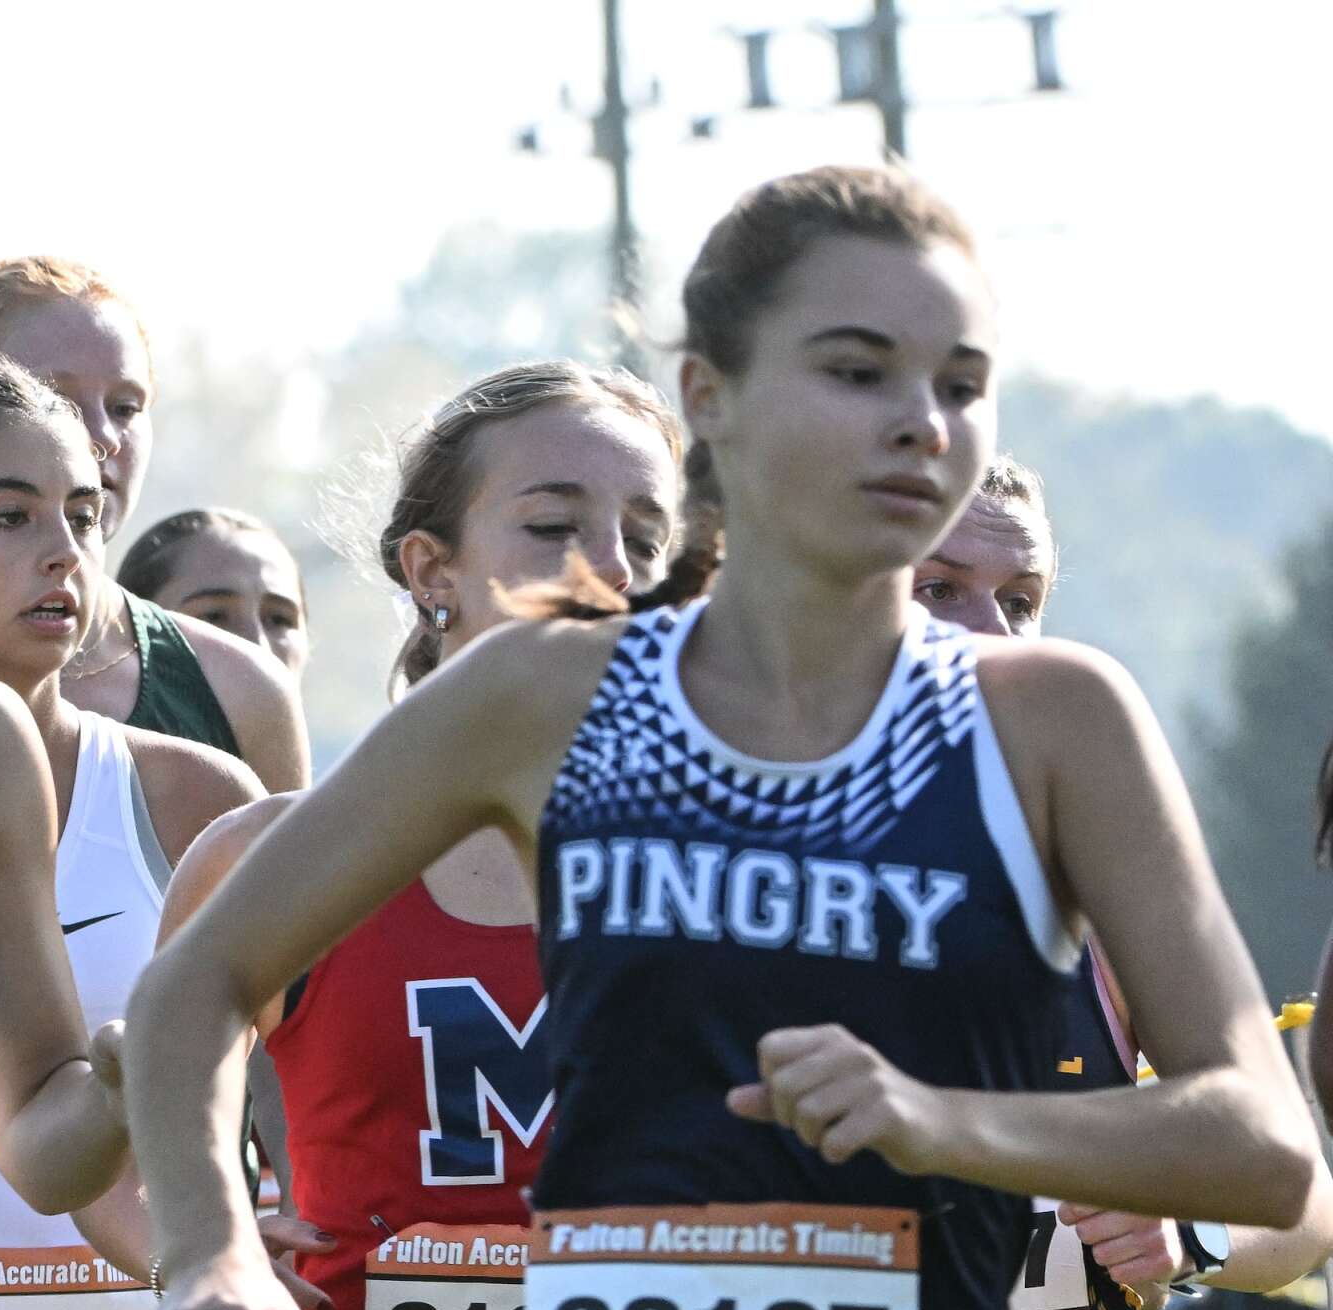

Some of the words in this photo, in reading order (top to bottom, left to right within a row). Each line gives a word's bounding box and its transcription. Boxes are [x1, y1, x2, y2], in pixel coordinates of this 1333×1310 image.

[555, 836, 968, 970] PINGRY
[405, 977, 555, 1186] M
[377, 1235, 464, 1265] Fulton
[549, 1223, 646, 1254] Fulton
[648, 1219, 788, 1254] Accurate
[793, 1221, 894, 1266] Timing
